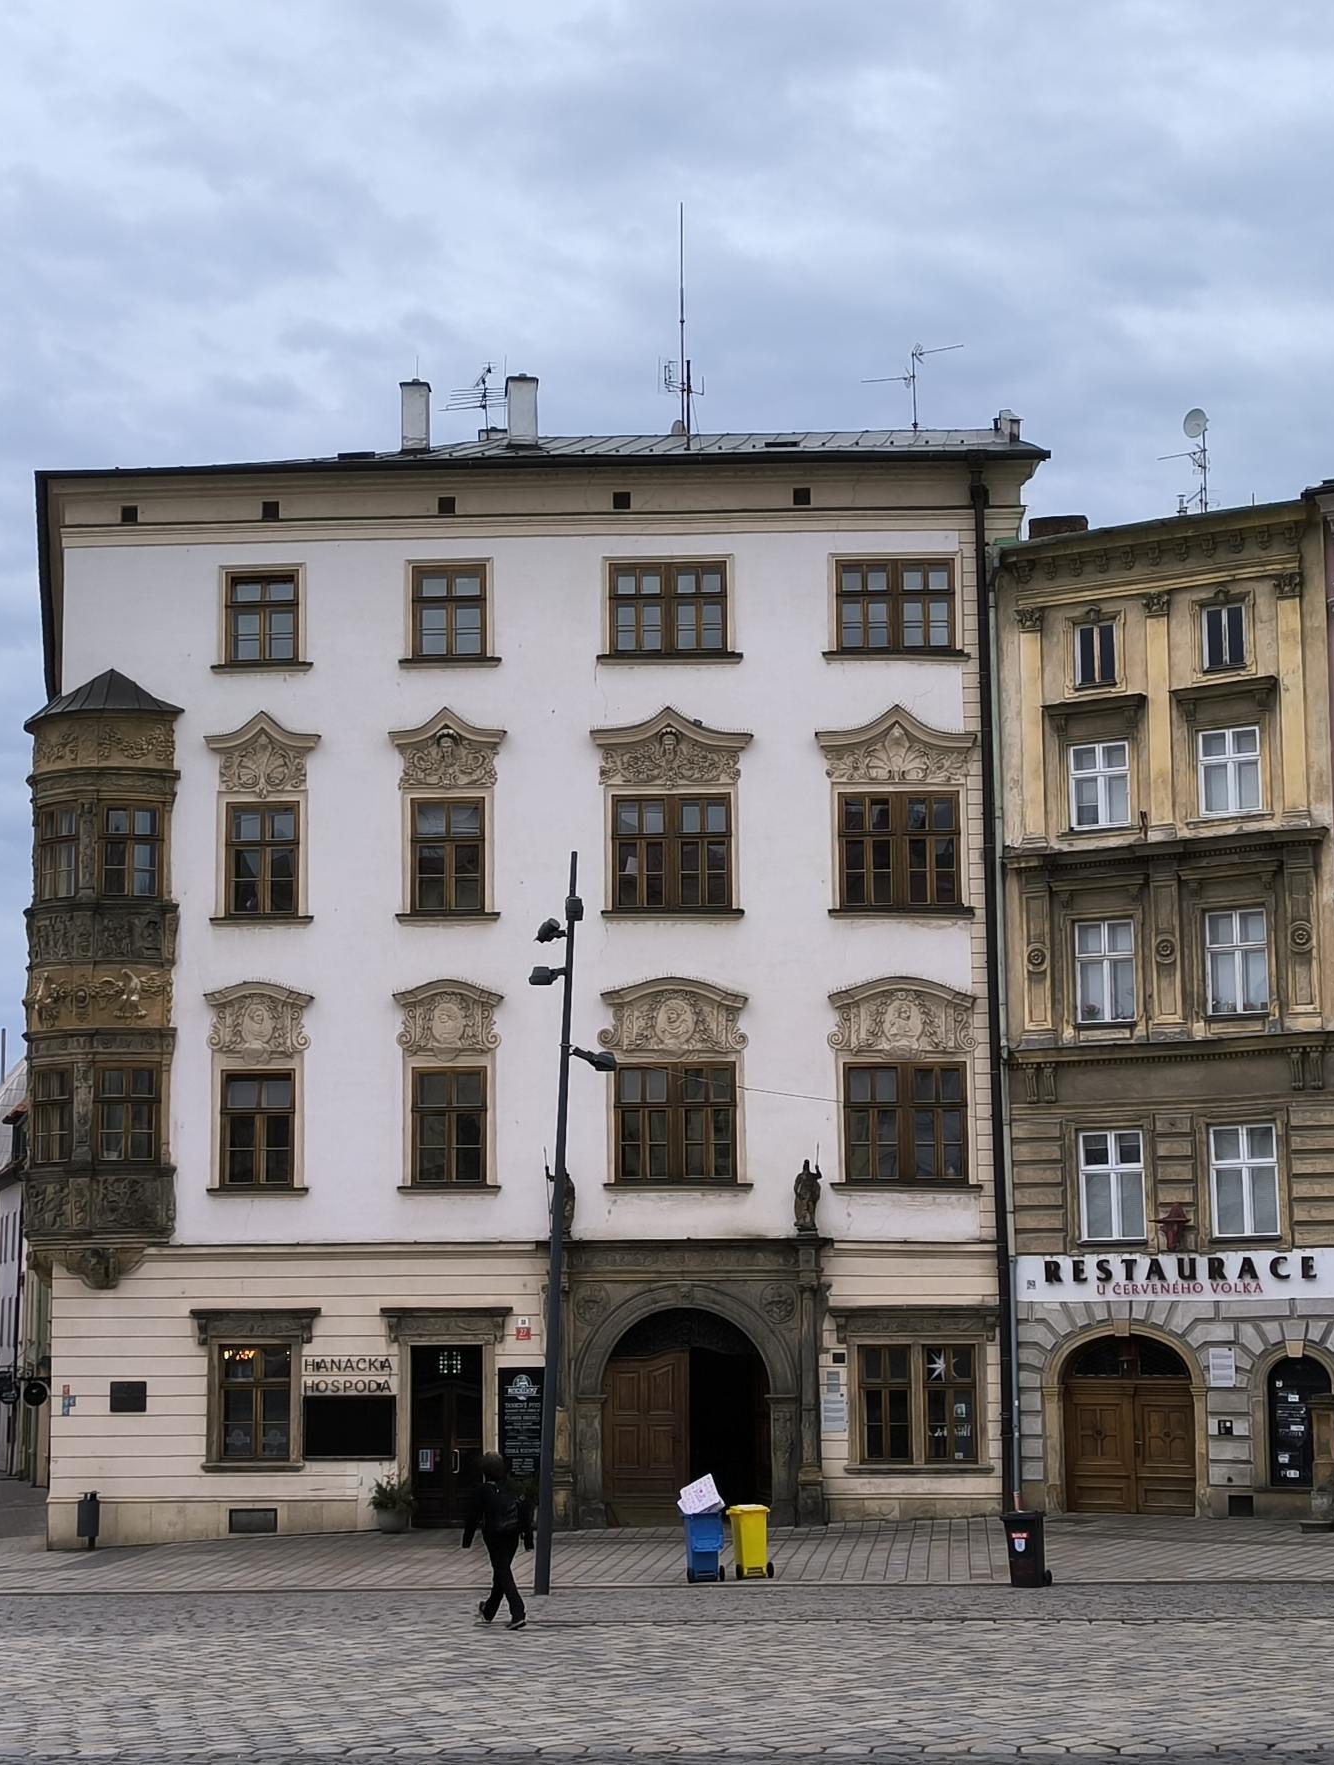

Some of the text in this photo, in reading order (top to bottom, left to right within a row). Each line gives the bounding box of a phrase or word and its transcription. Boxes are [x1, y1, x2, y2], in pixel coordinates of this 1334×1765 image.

[1044, 1255, 1318, 1284] RESTAURACE
[1097, 1281, 1264, 1295] U ČERVENÉHO VOLKA
[304, 1379, 392, 1393] HOSPODA
